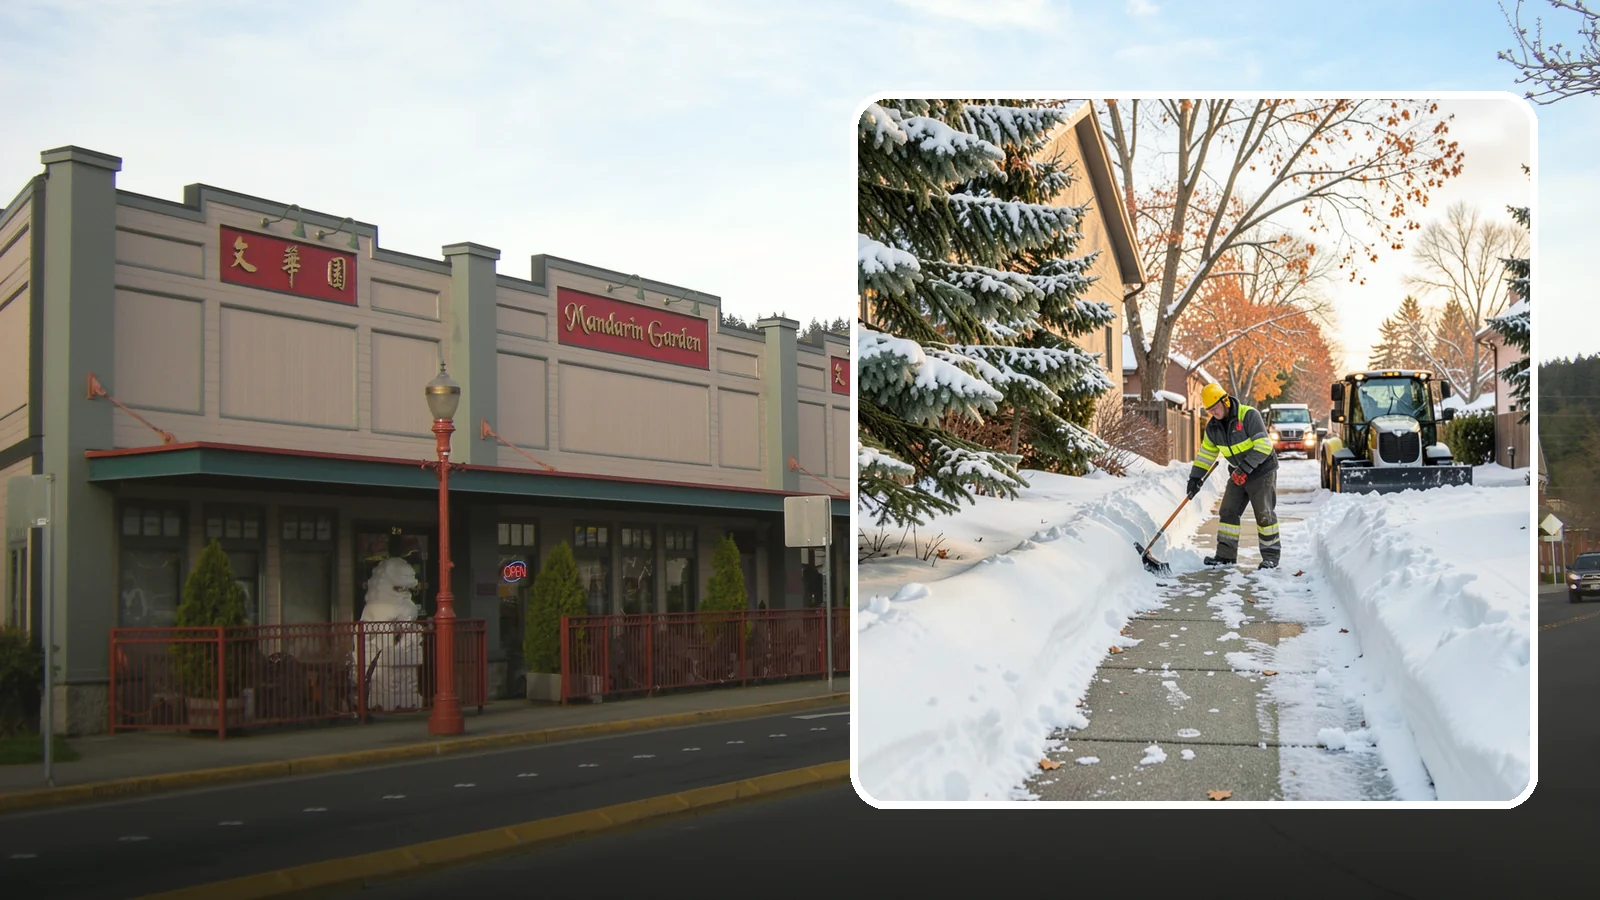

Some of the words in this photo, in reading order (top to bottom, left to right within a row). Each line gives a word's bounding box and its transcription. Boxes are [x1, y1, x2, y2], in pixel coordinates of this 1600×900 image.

[231, 236, 346, 290] 文華園
[564, 302, 643, 341] Mandarin
[647, 320, 701, 352] Garden
[503, 565, 527, 578] OPEN
